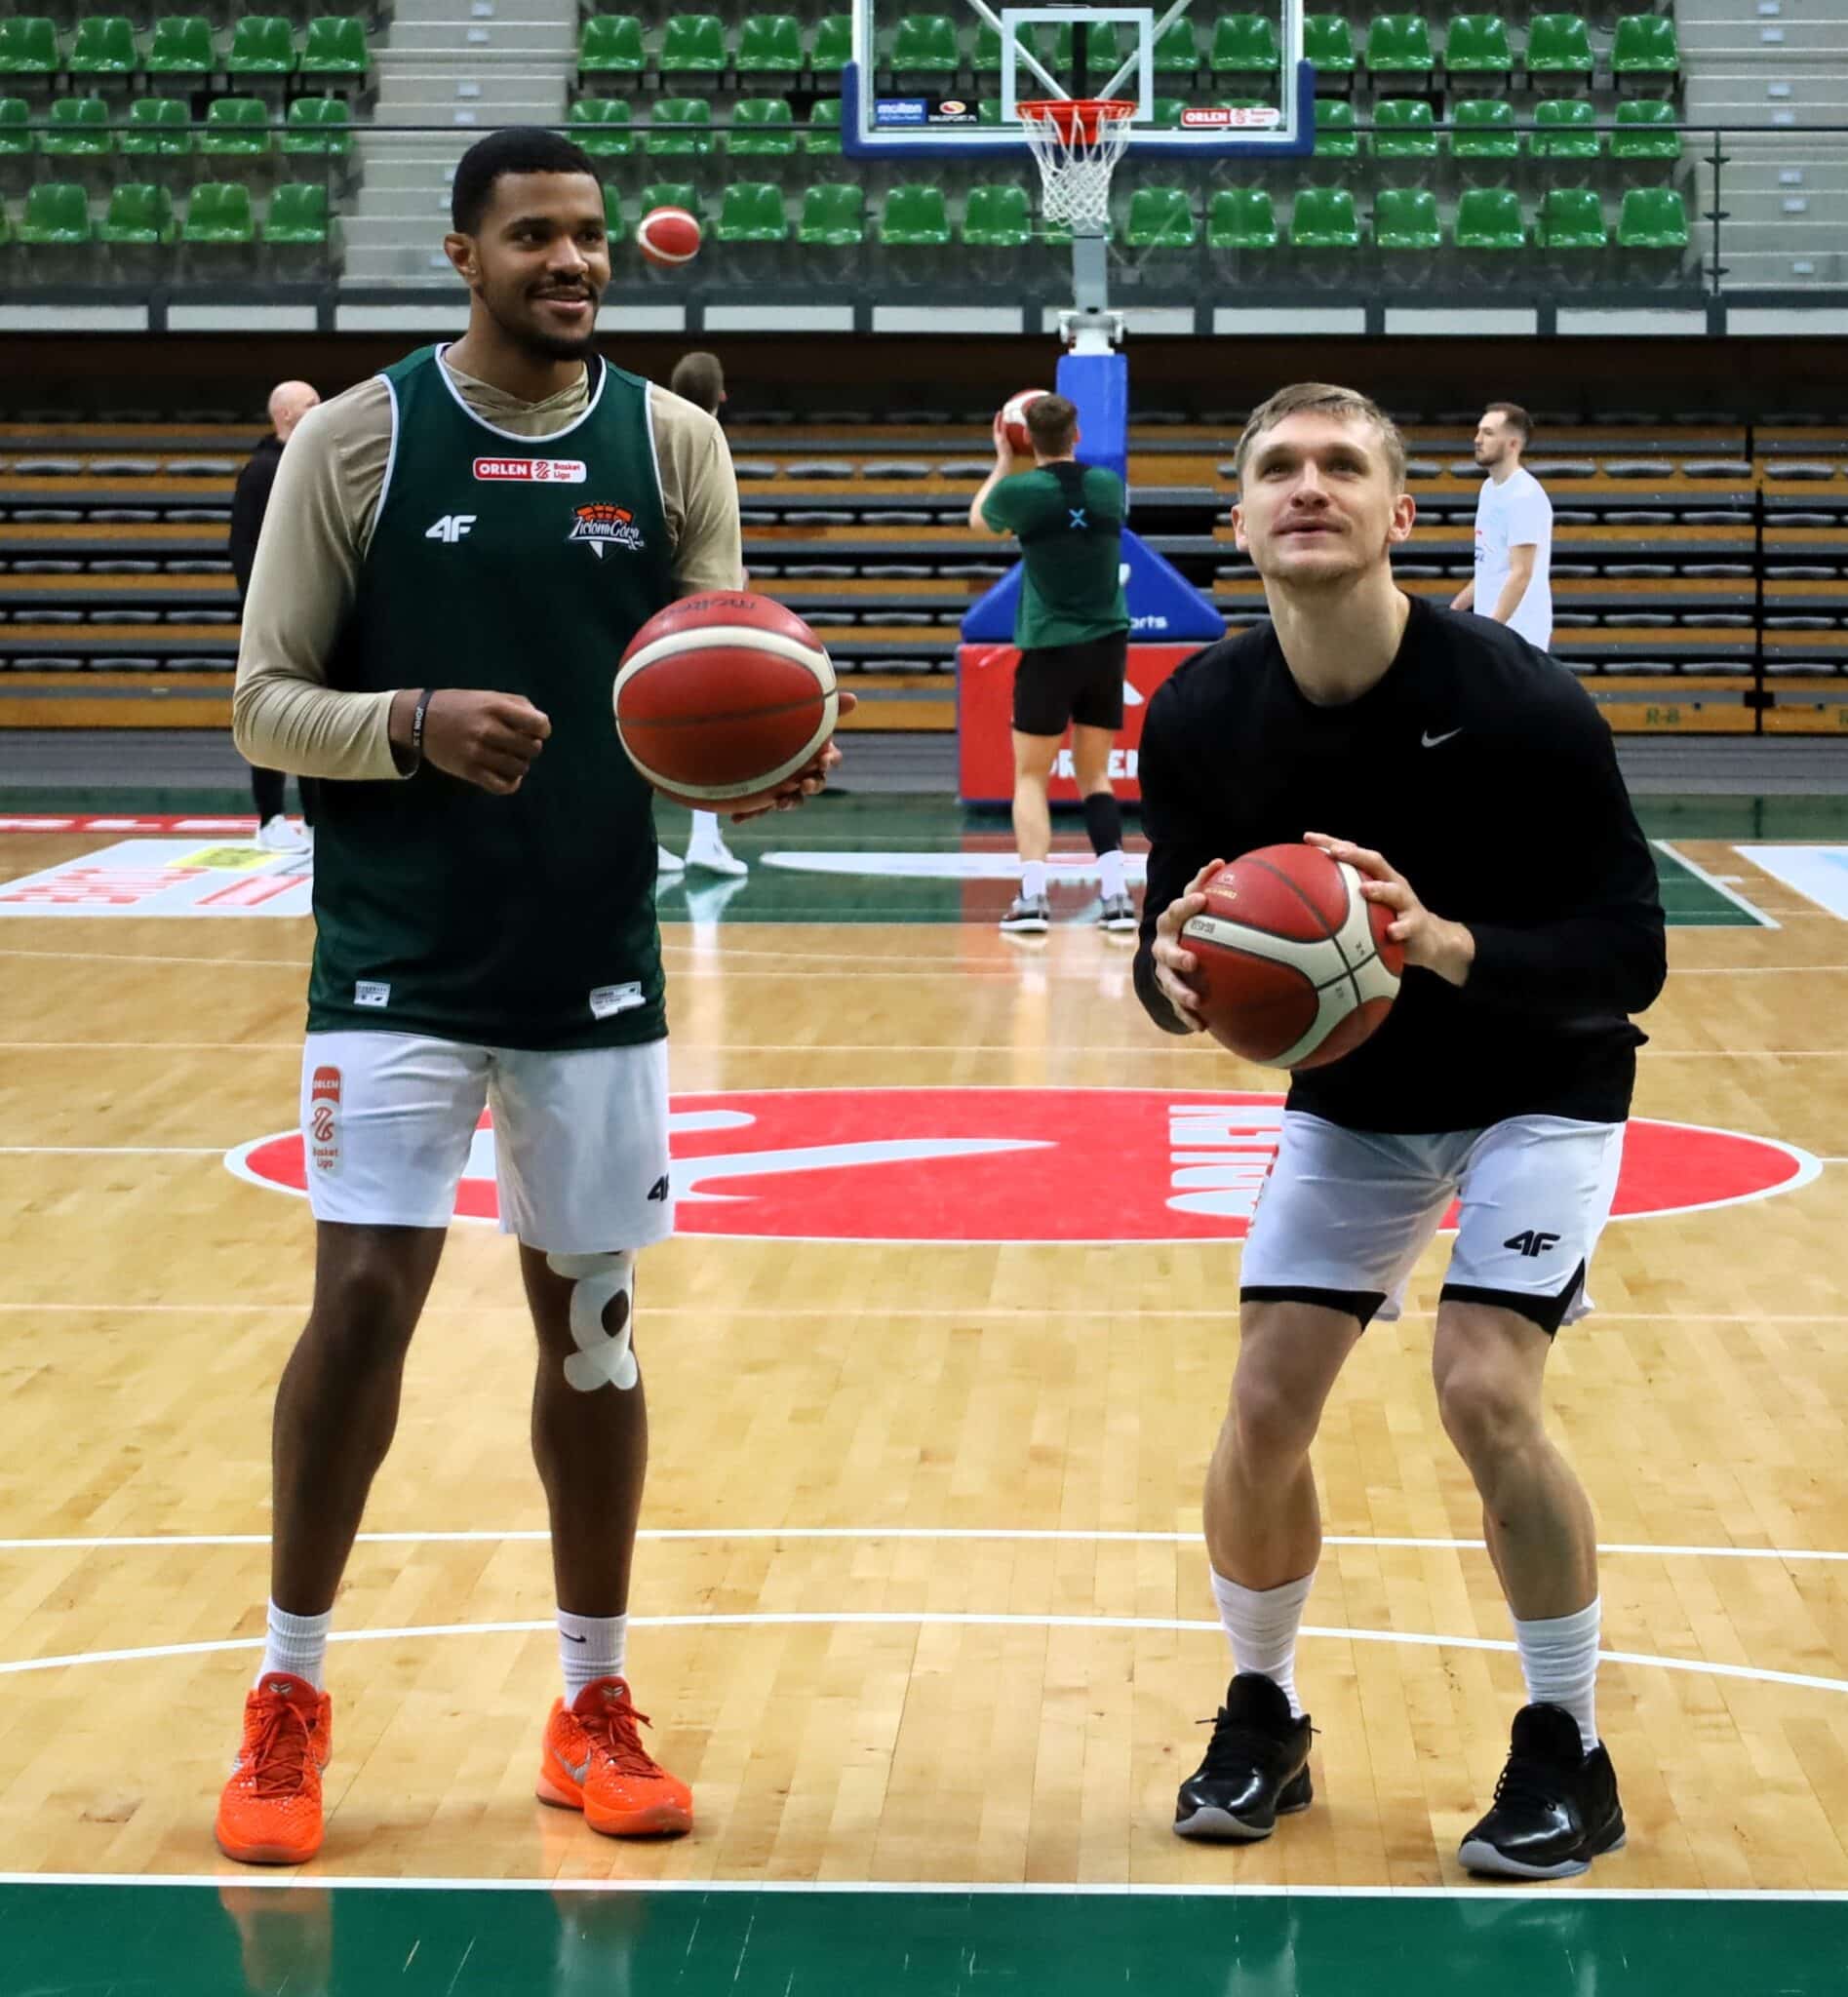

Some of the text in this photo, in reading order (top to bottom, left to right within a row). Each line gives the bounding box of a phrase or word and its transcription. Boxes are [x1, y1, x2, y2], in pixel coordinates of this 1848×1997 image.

[1185, 112, 1229, 123] ORLEN
[479, 464, 528, 476] ORLEN
[553, 462, 581, 472] Basket
[553, 471, 571, 480] Liga
[425, 515, 477, 543] 4F
[1128, 615, 1168, 630] orts
[1503, 1230, 1561, 1258] 4F
